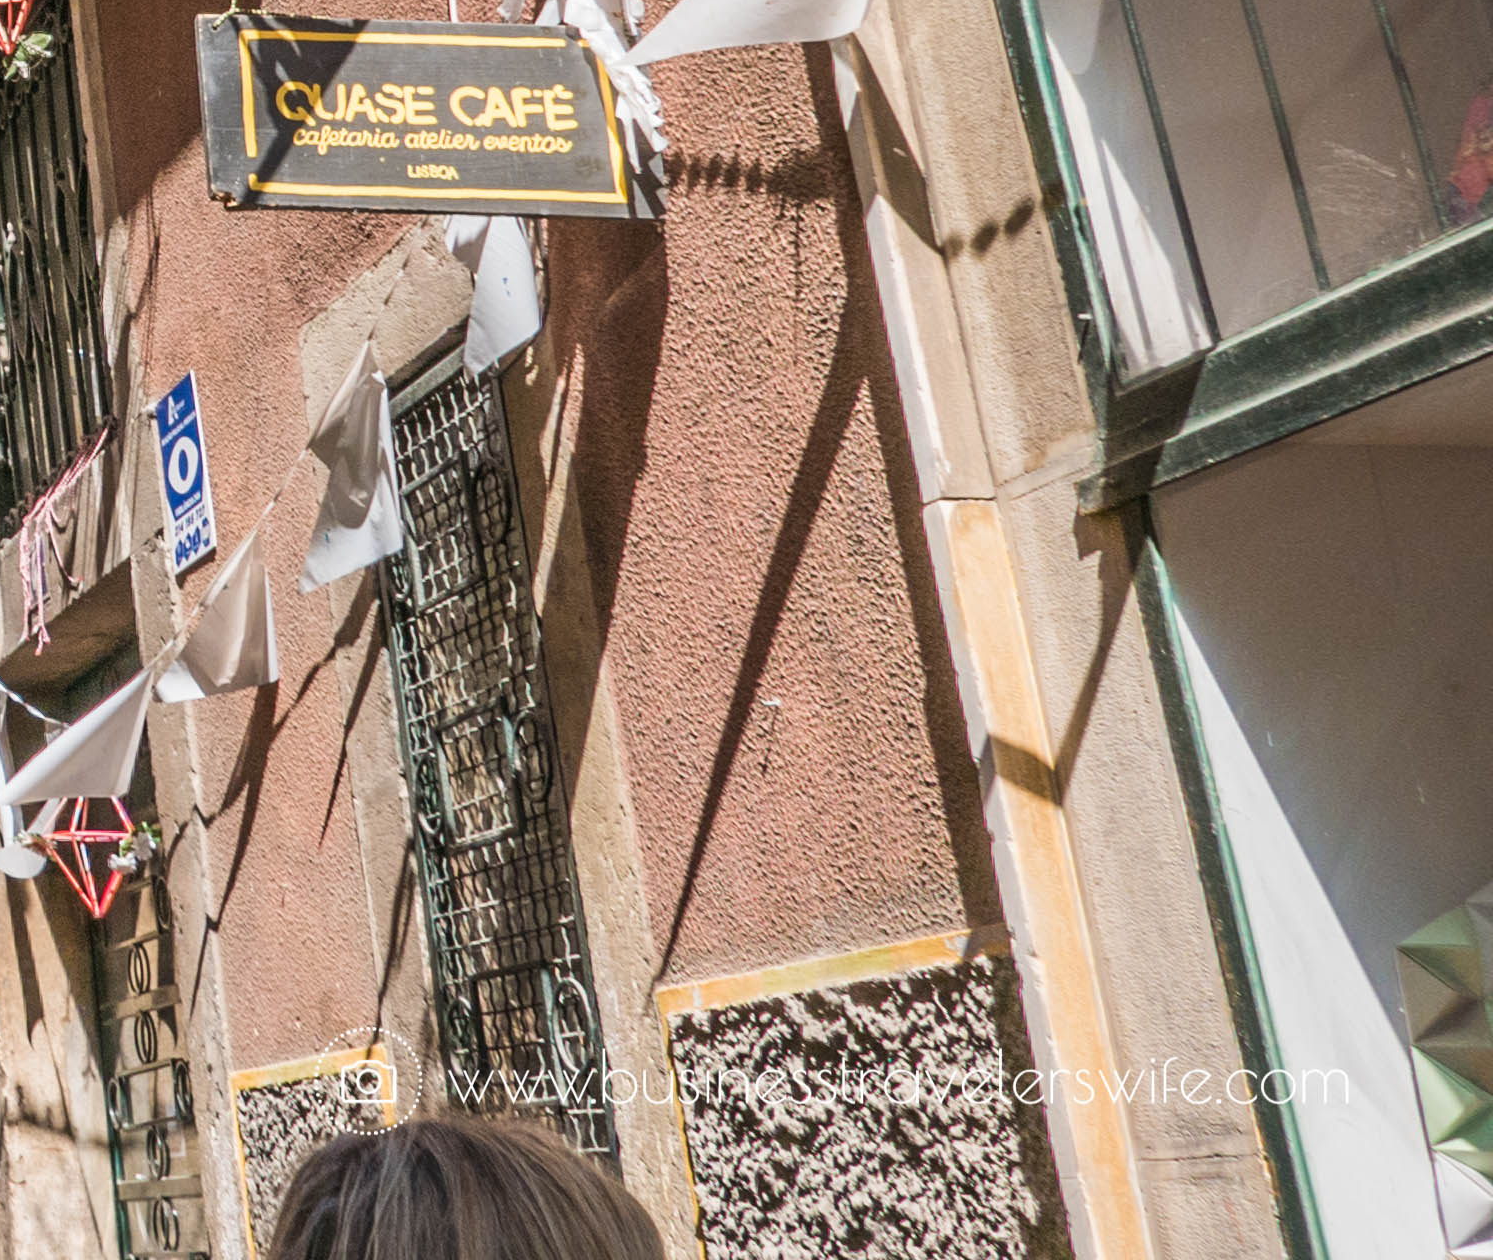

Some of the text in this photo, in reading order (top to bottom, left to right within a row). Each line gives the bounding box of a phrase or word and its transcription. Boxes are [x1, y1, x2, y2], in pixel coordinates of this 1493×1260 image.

[275, 81, 579, 131] QUASE CAFÉ
[293, 125, 573, 156] cafetaria atelier eventos
[406, 164, 460, 181] LISBOA
